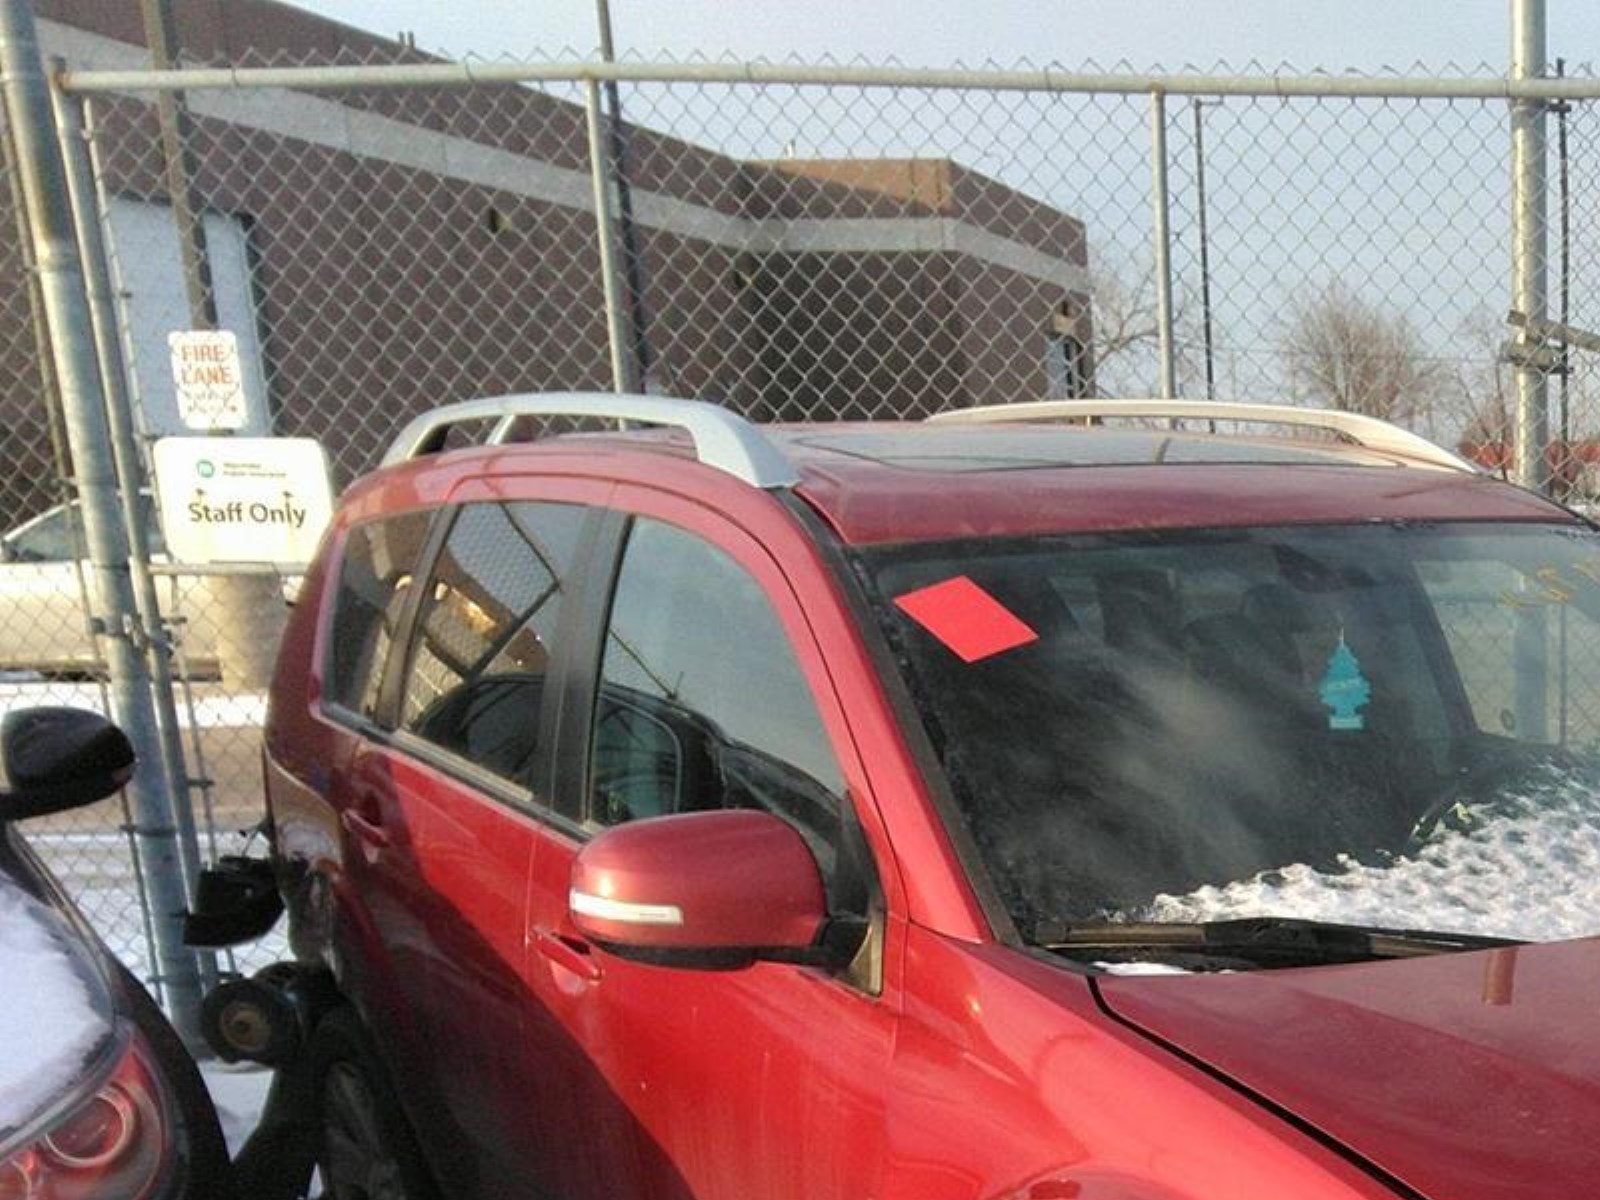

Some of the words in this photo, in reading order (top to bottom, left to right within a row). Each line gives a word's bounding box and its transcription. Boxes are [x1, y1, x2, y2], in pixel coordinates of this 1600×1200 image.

[181, 345, 225, 361] FIRE
[181, 367, 232, 384] LANE
[188, 502, 243, 522] Staff
[249, 501, 307, 528] Only
